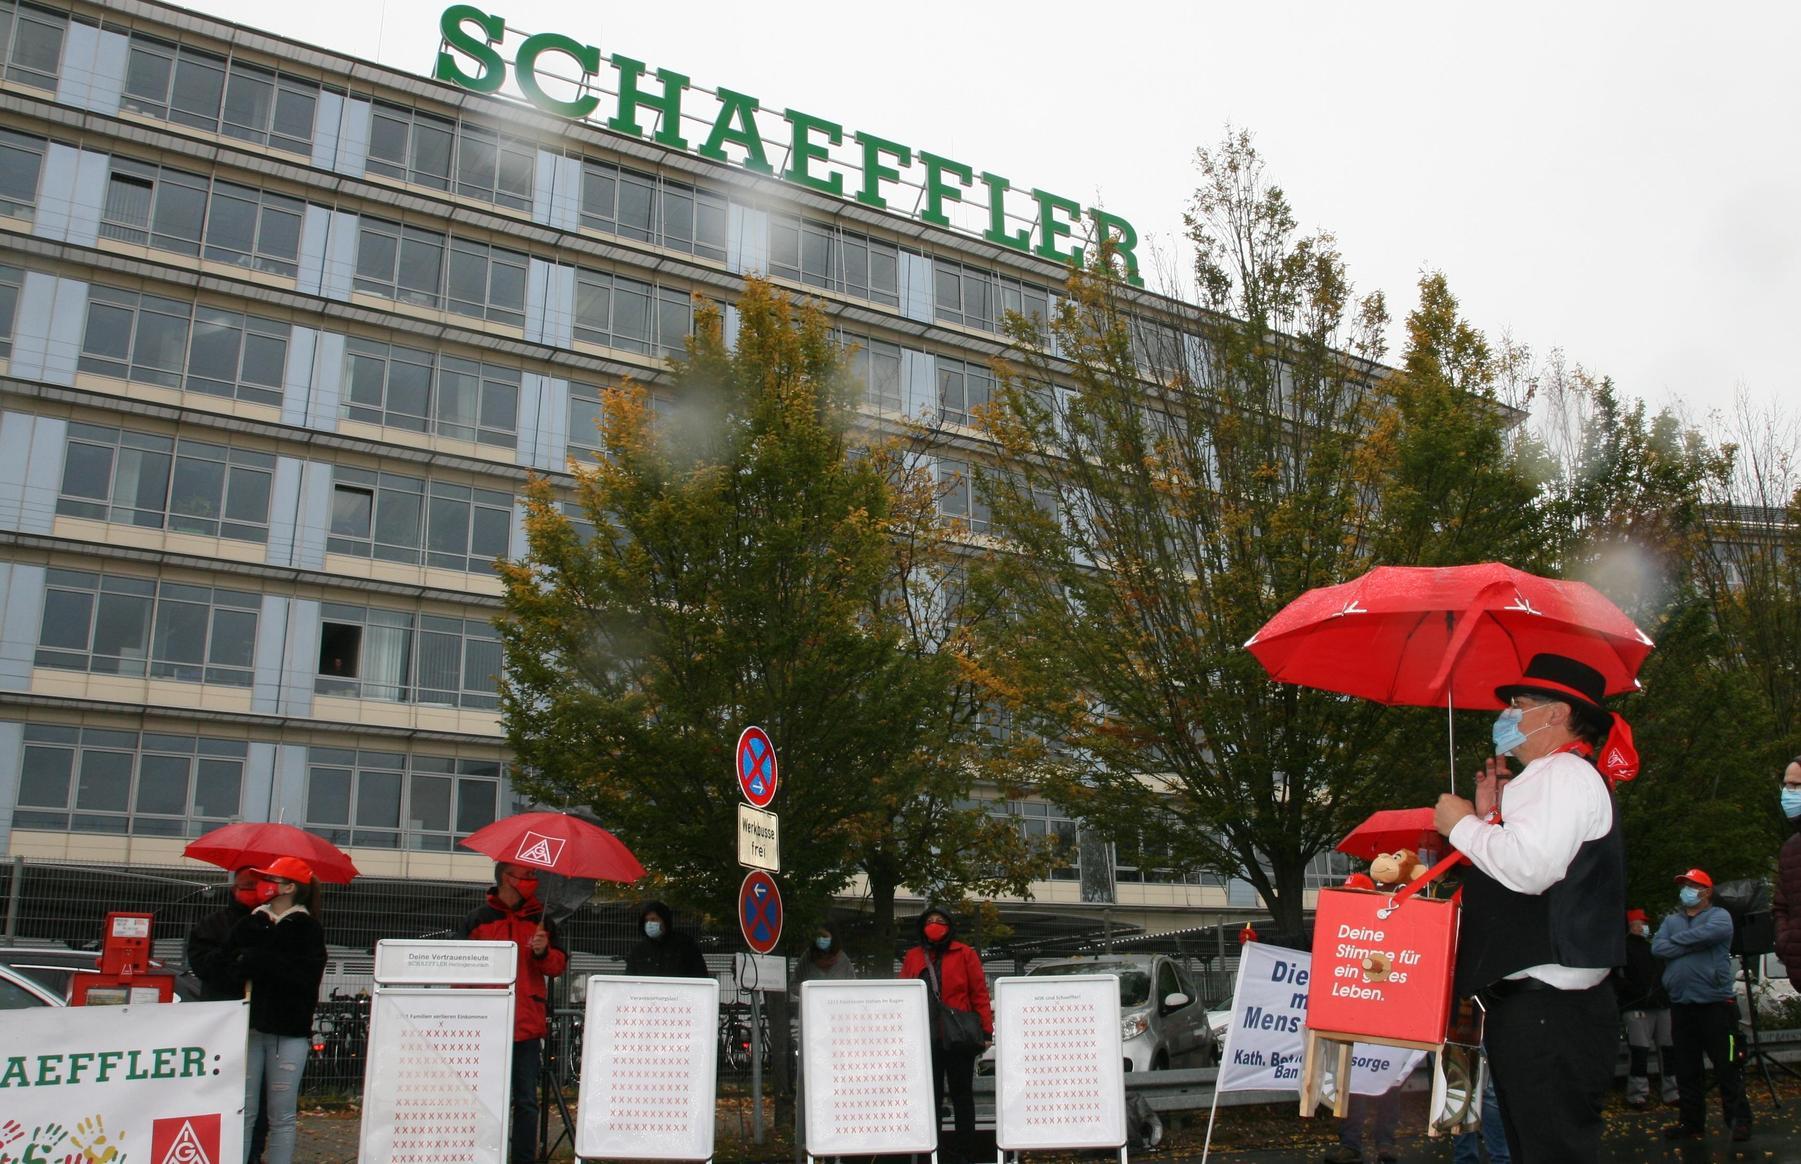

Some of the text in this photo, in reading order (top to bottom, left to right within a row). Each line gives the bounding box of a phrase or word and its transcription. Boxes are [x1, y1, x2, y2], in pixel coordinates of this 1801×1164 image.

[436, 4, 1145, 288] SCHAEFFLER
[742, 816, 775, 840] Werkbusse
[751, 841, 766, 858] frei
[1338, 924, 1385, 942] Deine
[432, 953, 489, 961] Vertrauensleute
[1399, 950, 1421, 965] für
[1334, 964, 1359, 978] ein
[1332, 982, 1385, 1001] Leben.
[1233, 1049, 1266, 1067] Kath.
